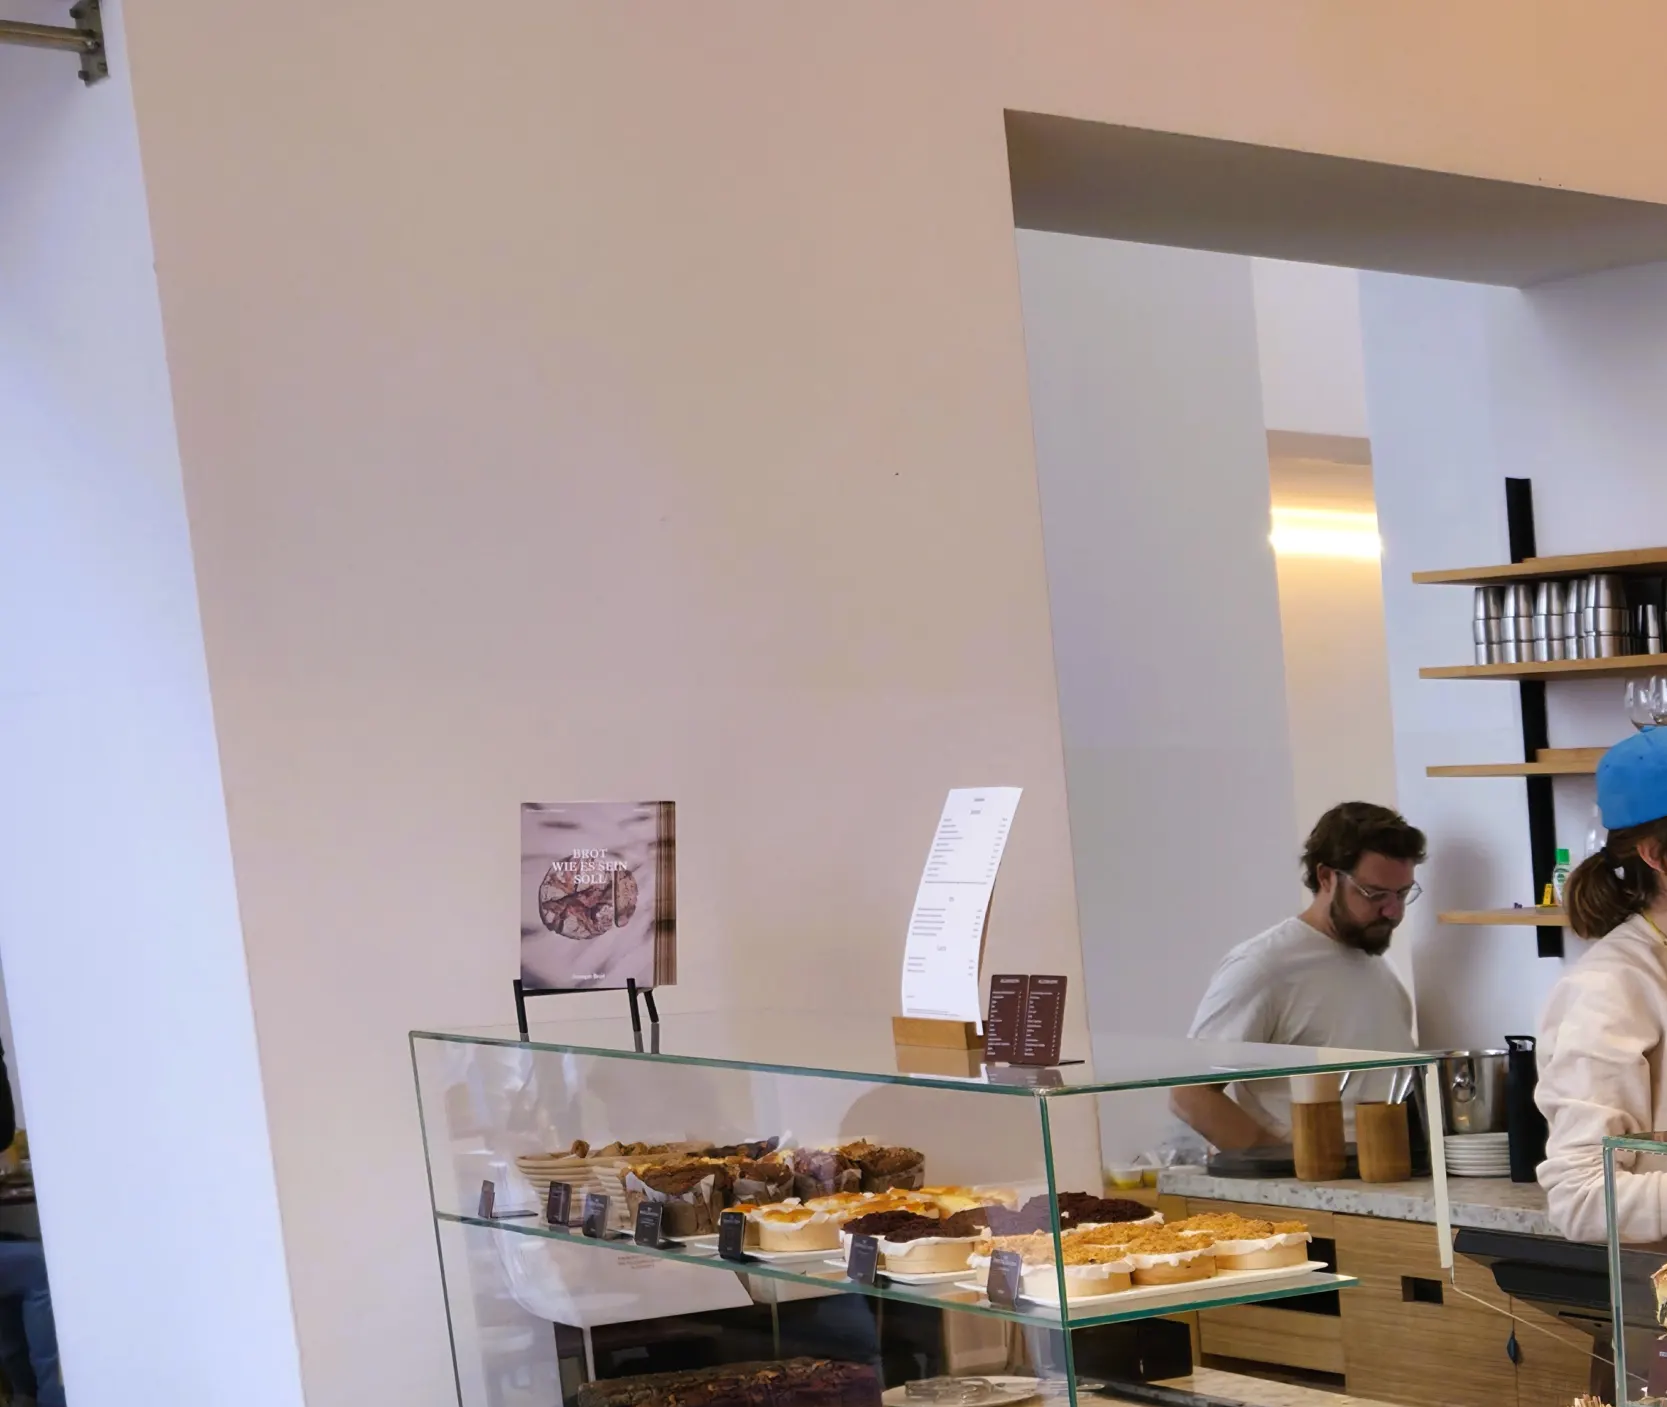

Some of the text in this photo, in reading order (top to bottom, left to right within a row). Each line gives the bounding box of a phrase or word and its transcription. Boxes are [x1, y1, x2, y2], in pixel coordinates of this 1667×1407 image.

[572, 848, 608, 859] BROT
[551, 861, 628, 872] WIE ES SEIN
[573, 874, 607, 885] SOLL
